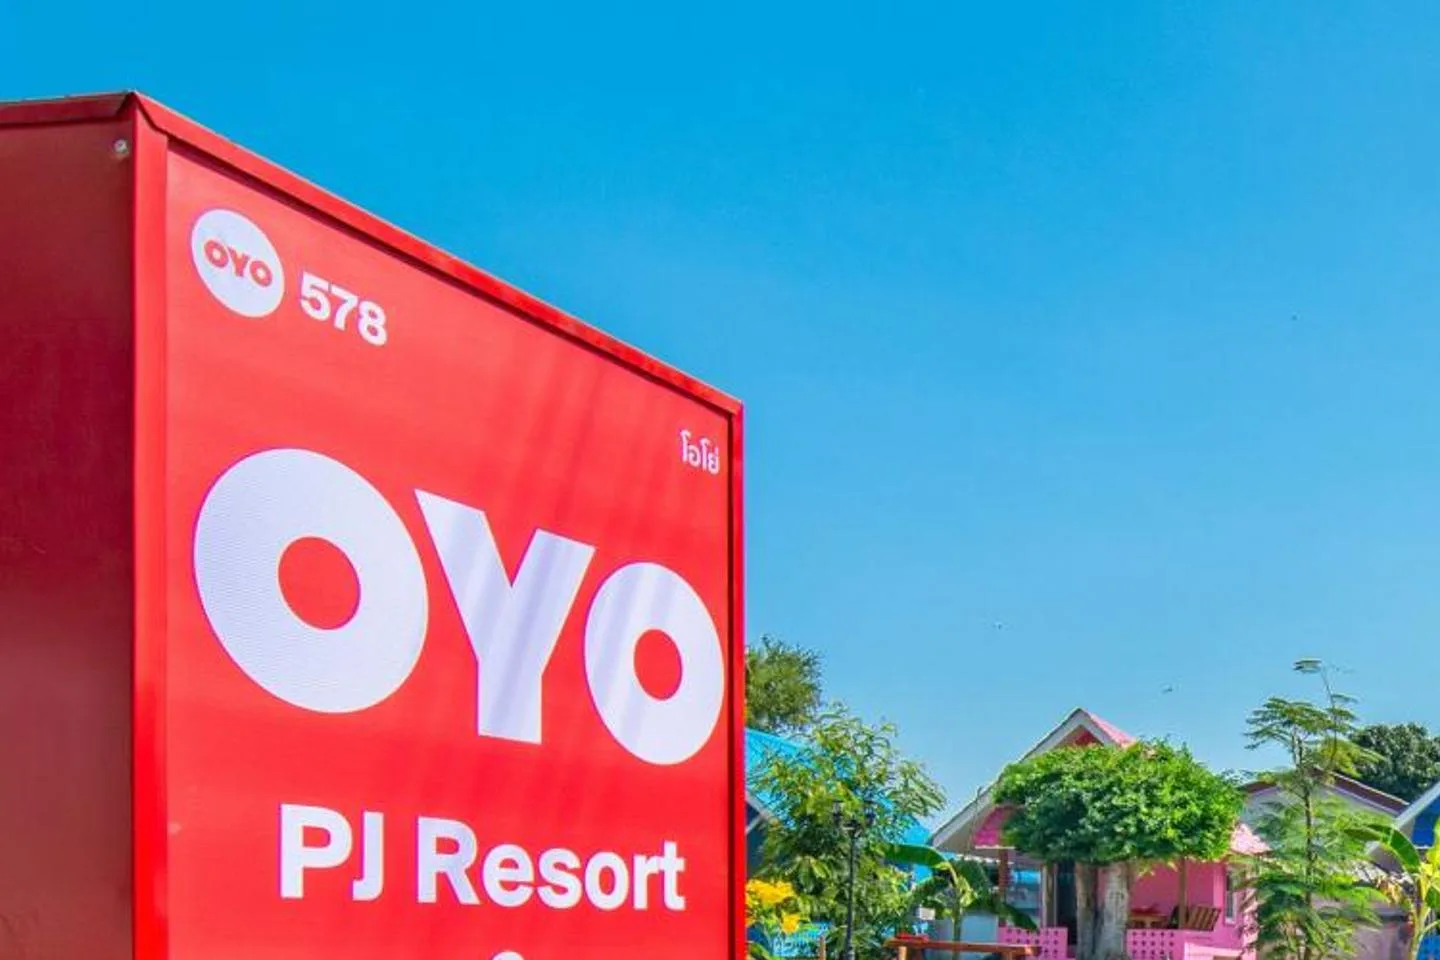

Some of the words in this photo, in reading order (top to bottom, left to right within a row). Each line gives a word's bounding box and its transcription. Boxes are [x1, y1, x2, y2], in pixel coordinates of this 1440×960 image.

[204, 239, 273, 287] OYO
[300, 271, 388, 346] 578
[194, 448, 725, 765] OYO
[280, 803, 384, 901] PJ
[418, 816, 686, 910] Resort
